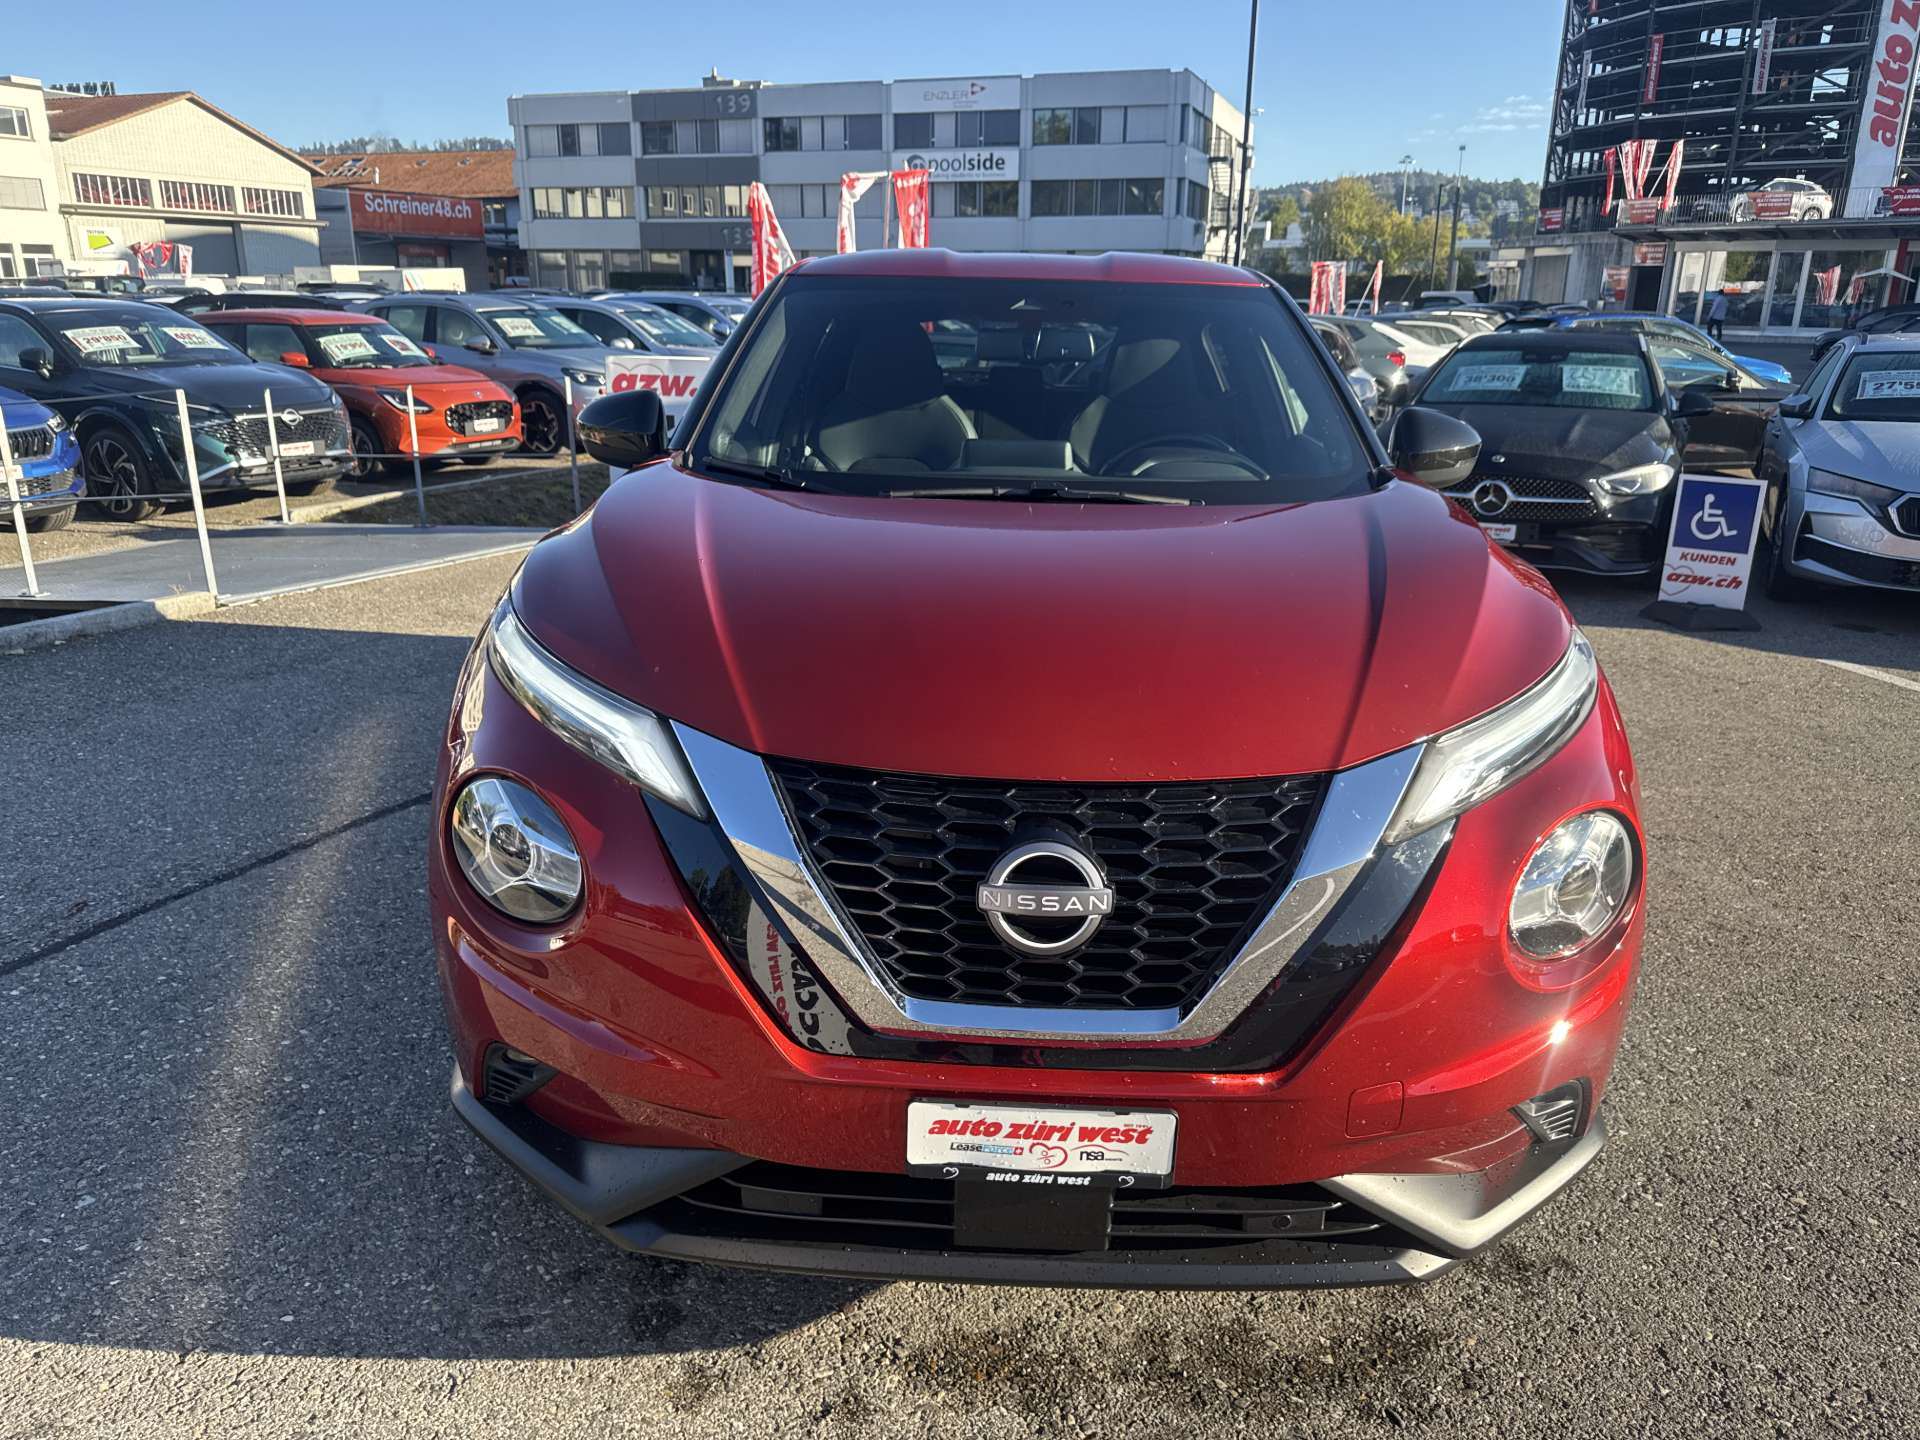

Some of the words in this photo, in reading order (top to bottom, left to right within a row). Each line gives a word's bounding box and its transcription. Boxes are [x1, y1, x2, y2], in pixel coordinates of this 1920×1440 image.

[923, 90, 969, 101] ENZLER
[1869, 34, 1913, 147] auto
[716, 94, 750, 113] 139
[928, 152, 1005, 176] poolside
[364, 192, 471, 218] Schreiner48.ch
[611, 373, 698, 397] azw.
[1679, 552, 1737, 566] KUNDEN
[1666, 573, 1742, 589] azw.ch
[982, 890, 1108, 911] NISSAN
[928, 1117, 1003, 1137] auto
[1004, 1120, 1076, 1142] züri
[1078, 1124, 1153, 1144] west
[1079, 1151, 1104, 1161] nsa
[986, 1171, 1020, 1182] auto
[1022, 1172, 1054, 1184] züri
[1056, 1174, 1092, 1185] west
